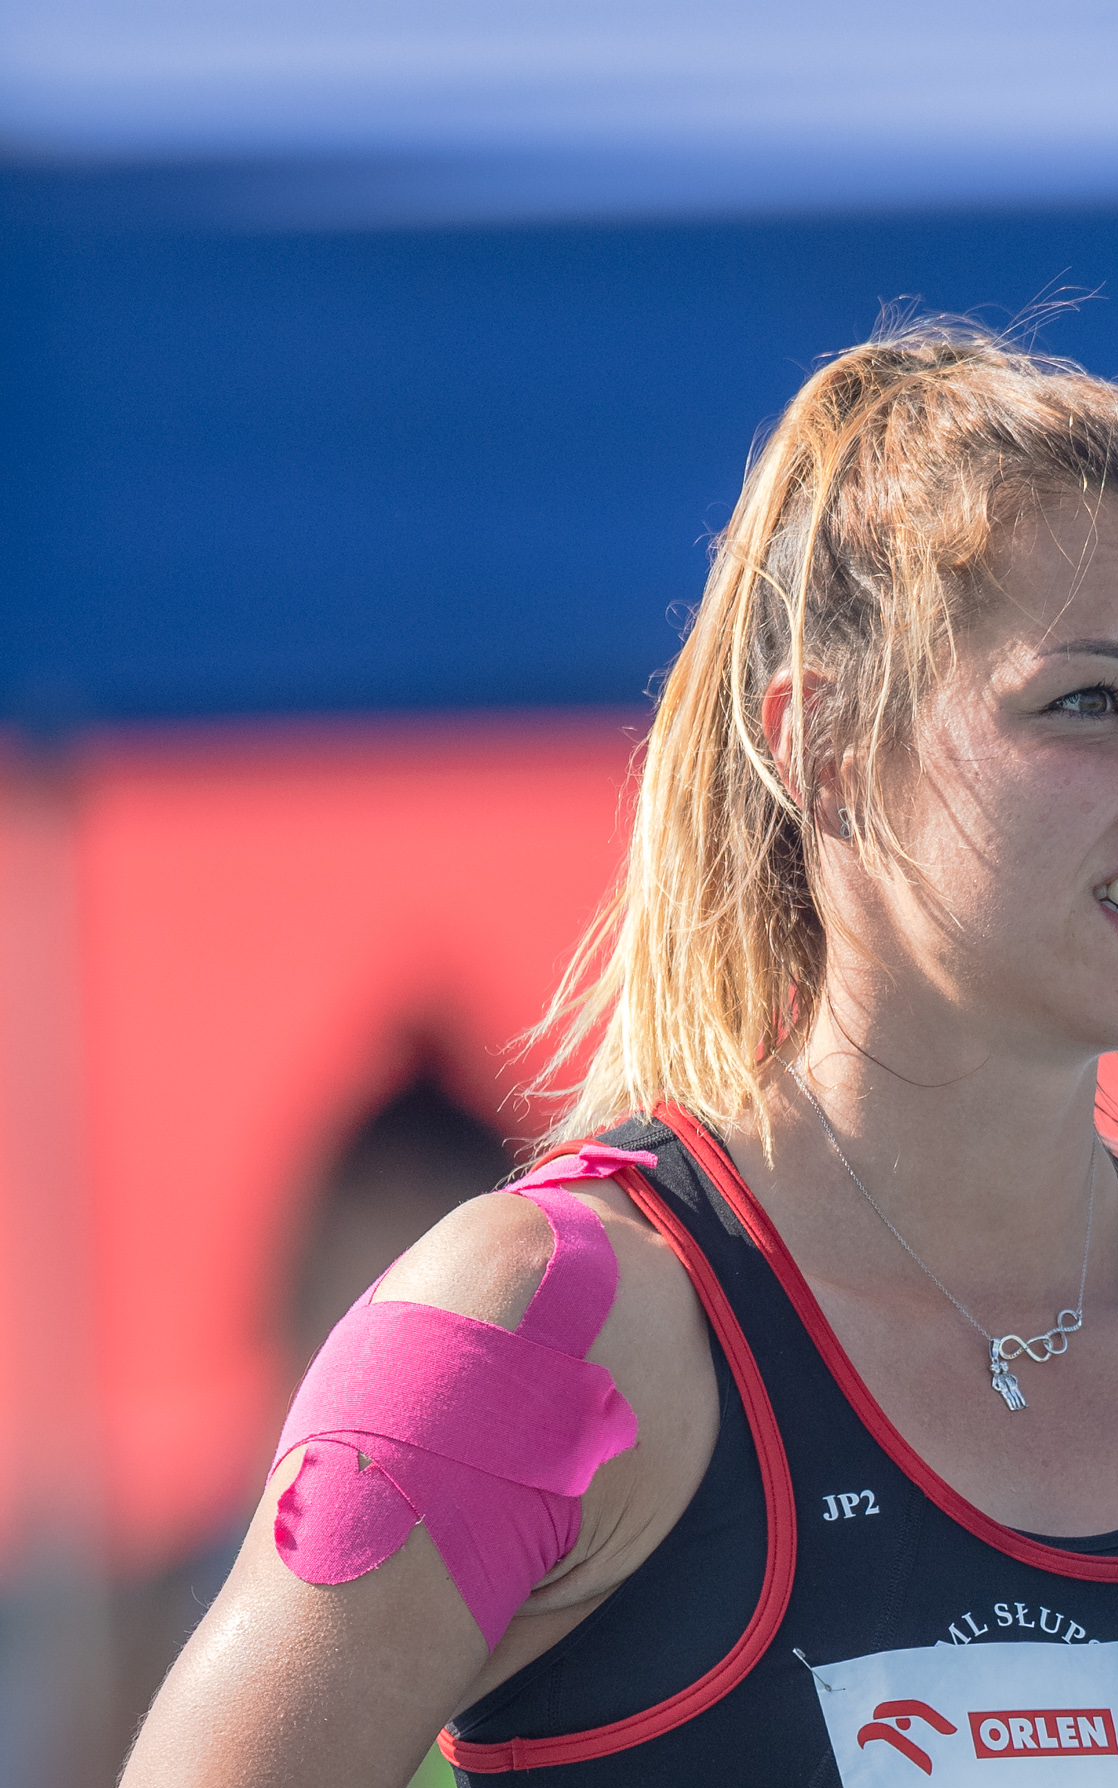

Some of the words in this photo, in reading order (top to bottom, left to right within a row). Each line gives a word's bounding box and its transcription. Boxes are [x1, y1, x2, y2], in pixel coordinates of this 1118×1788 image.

[822, 1489, 880, 1521] JP2
[993, 1602, 1101, 1645] SŁUP
[978, 1715, 1109, 1751] ORLEN
